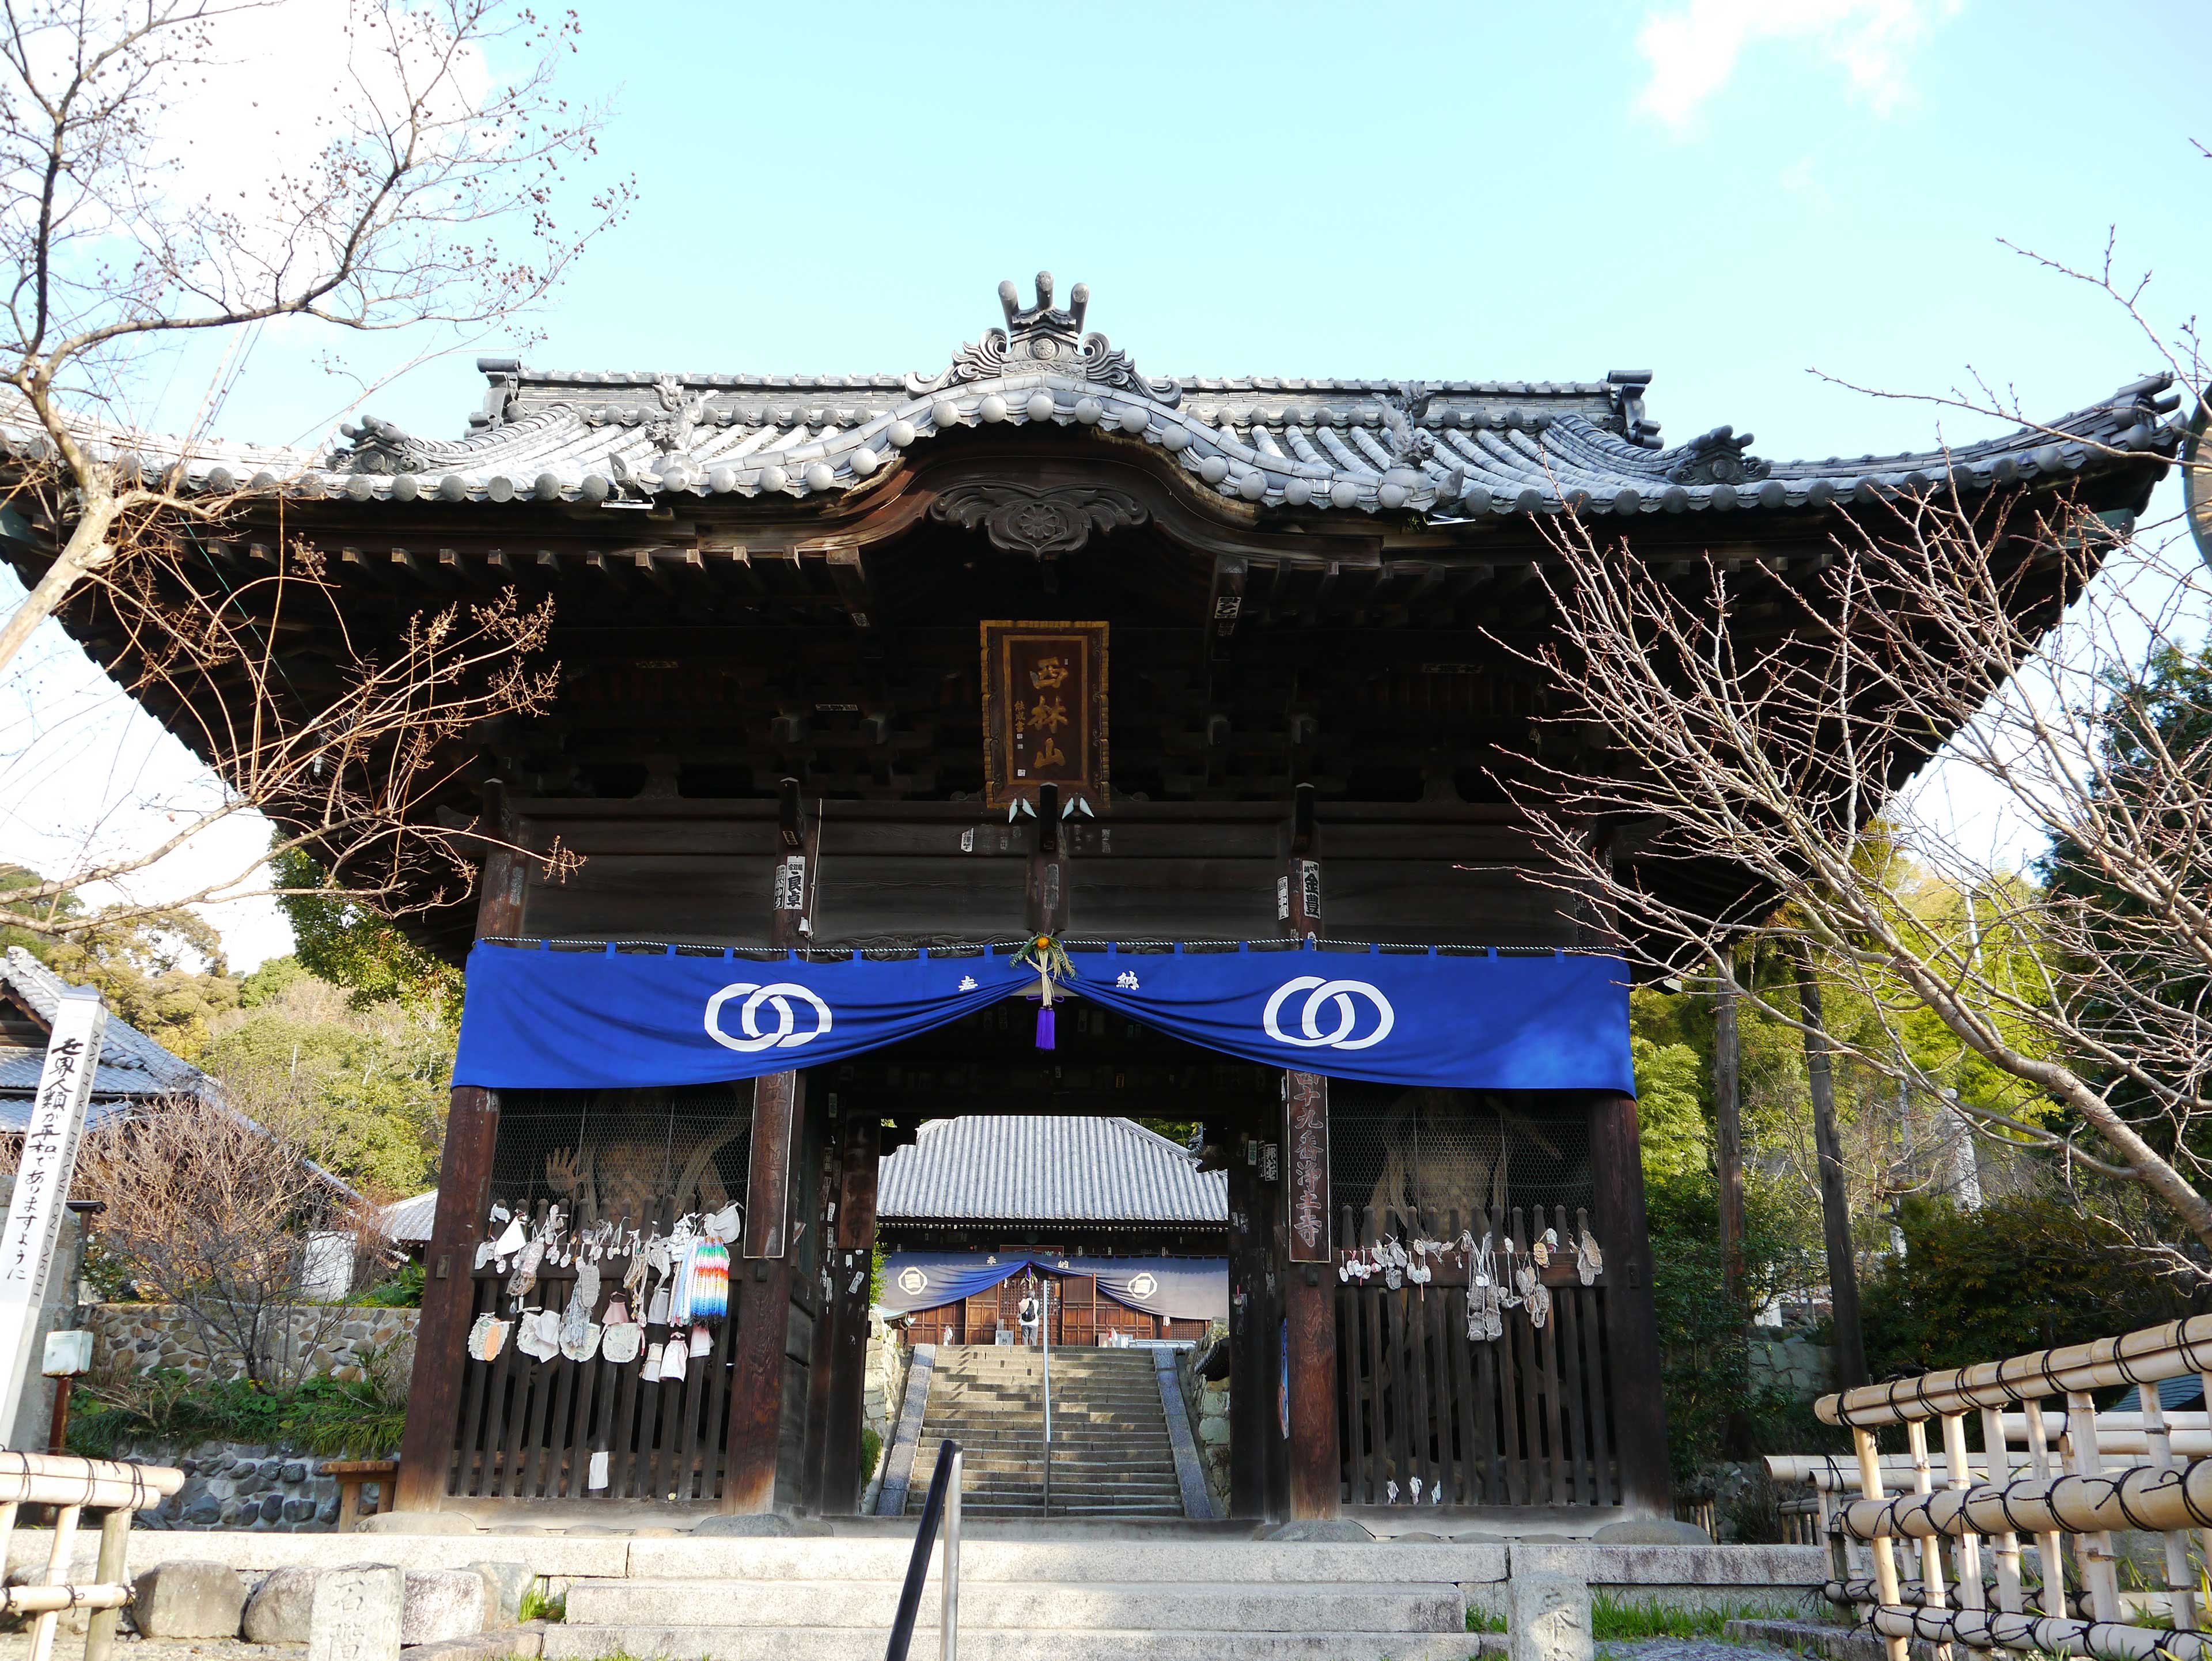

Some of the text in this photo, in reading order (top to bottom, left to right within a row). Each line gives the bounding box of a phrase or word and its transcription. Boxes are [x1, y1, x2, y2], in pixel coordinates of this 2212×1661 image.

[1028, 657, 1069, 769] 西林山
[1116, 970, 1139, 990] 納
[7, 1038, 84, 1280] 世界人類が平和でありますように
[33, 1031, 100, 1296] MAY PEACE PREVAIL ON EARTH
